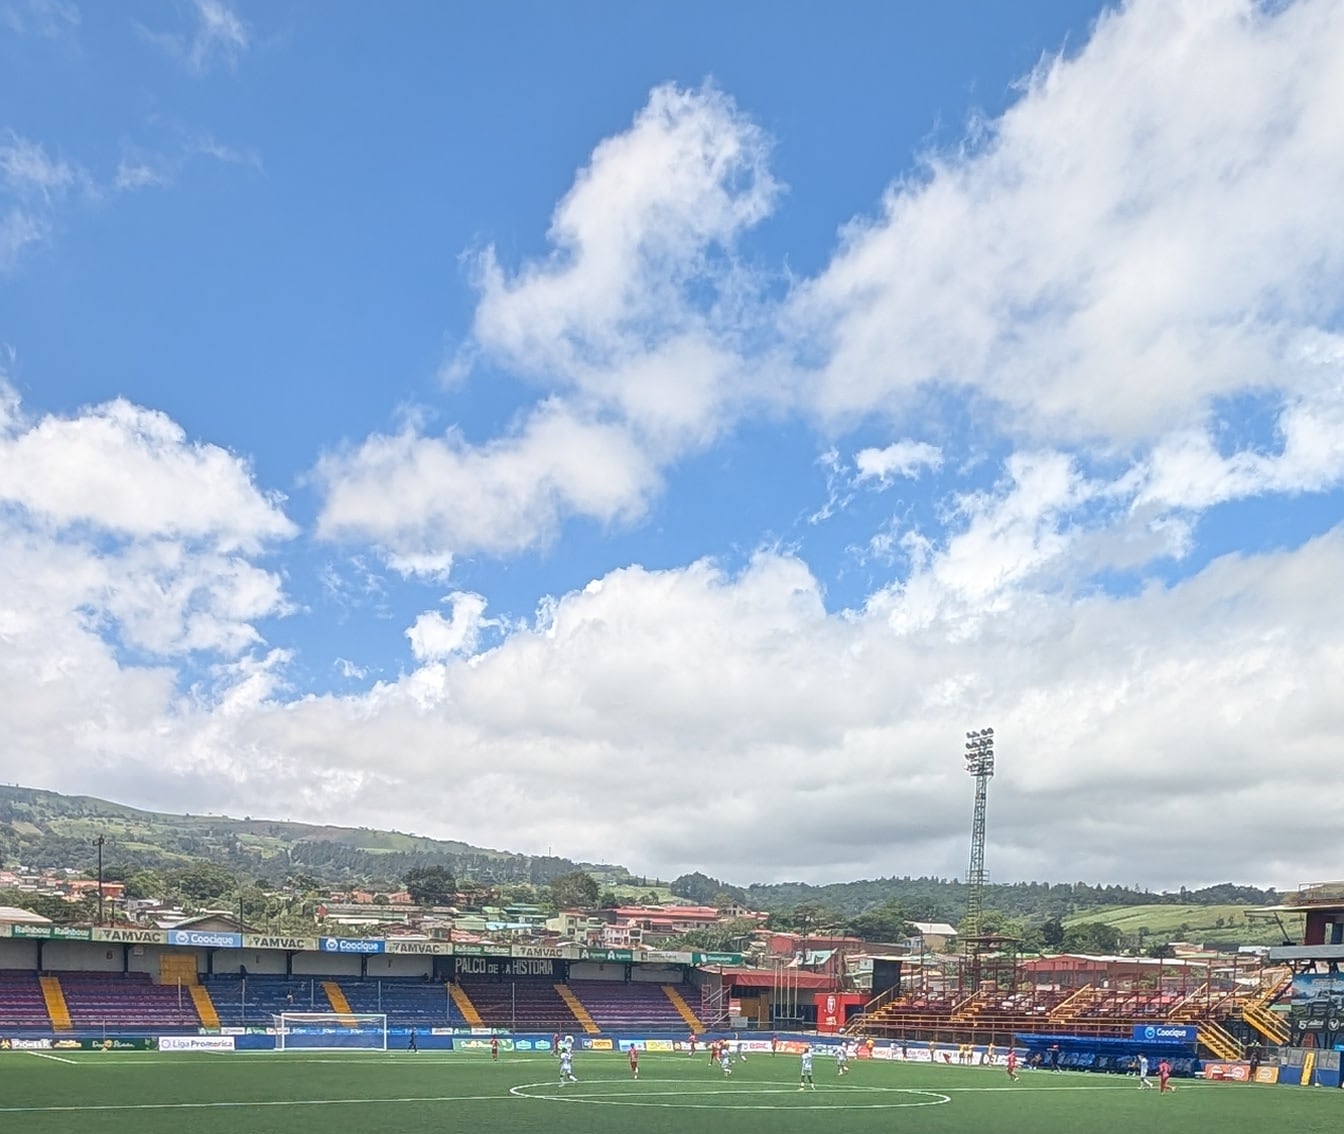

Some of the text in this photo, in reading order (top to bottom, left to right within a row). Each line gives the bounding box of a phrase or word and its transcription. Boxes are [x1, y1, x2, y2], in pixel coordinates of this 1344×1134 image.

[190, 933, 234, 946] Coocique
[339, 939, 379, 952] Coocique
[455, 957, 486, 974] PALCO
[488, 964, 499, 974] DE
[512, 959, 554, 975] HISTORIA
[1156, 1027, 1187, 1039] Coocique
[172, 1039, 190, 1049] Liga
